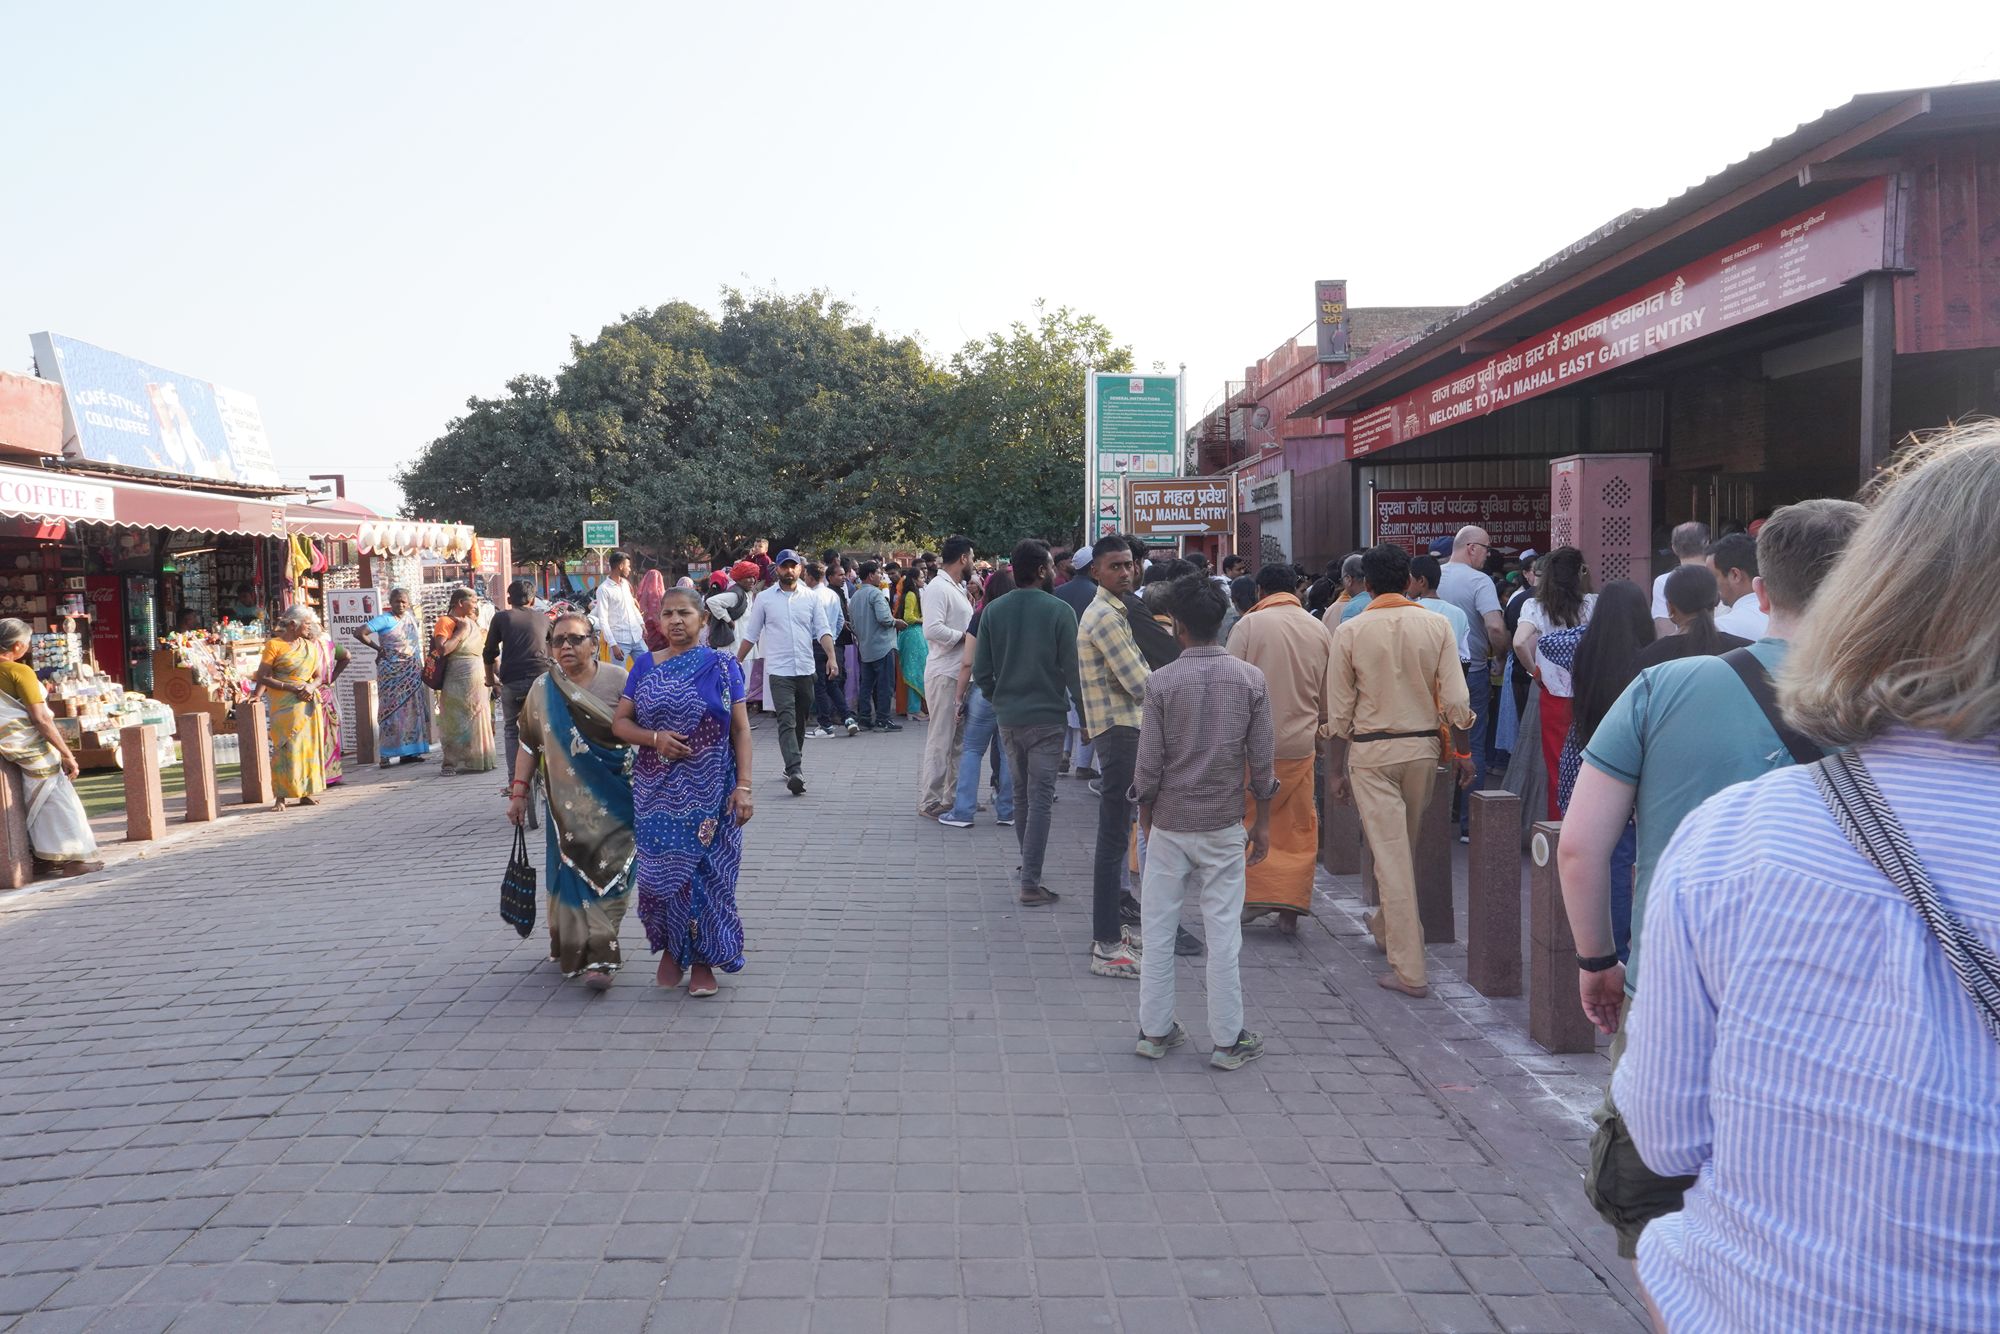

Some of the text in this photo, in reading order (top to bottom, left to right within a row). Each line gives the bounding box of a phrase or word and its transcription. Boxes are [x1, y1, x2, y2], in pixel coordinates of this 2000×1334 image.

[1431, 384, 1450, 404] ताज
[1451, 373, 1476, 394] महल
[1496, 353, 1523, 380] प्रवेश
[1524, 343, 1546, 369] द्वार
[1547, 331, 1561, 356] में
[1561, 316, 1609, 352] आपका
[1610, 290, 1666, 330] स्वागत
[1670, 275, 1686, 307] है
[1428, 306, 1706, 426] WELCOME TO TAJ MAHAL EAST GATE ENTRY
[108, 393, 144, 420] STYLE
[84, 410, 151, 437] COLD COFFEE
[0, 480, 88, 510] COFFEE
[1134, 490, 1161, 506] ताज
[1163, 489, 1196, 507] महल
[1197, 483, 1227, 507] प्रवेश
[1378, 501, 1406, 522] सुरक्षा
[1407, 495, 1429, 515] जाँच
[1430, 496, 1447, 515] एवं
[1447, 495, 1478, 514] पर्यटक
[1480, 494, 1510, 520] सुविधा
[1134, 506, 1228, 522] TAJ MAHAL ENTRY
[1380, 523, 1409, 535] SECURITY
[1410, 522, 1430, 534] CHECK
[1431, 522, 1444, 534] AND
[1503, 520, 1527, 533] CENTER
[1527, 520, 1535, 532] AT
[1535, 520, 1551, 532] EAST
[1503, 534, 1513, 544] OF
[1513, 534, 1532, 544] INDIA
[333, 615, 375, 624] AMERICAN
